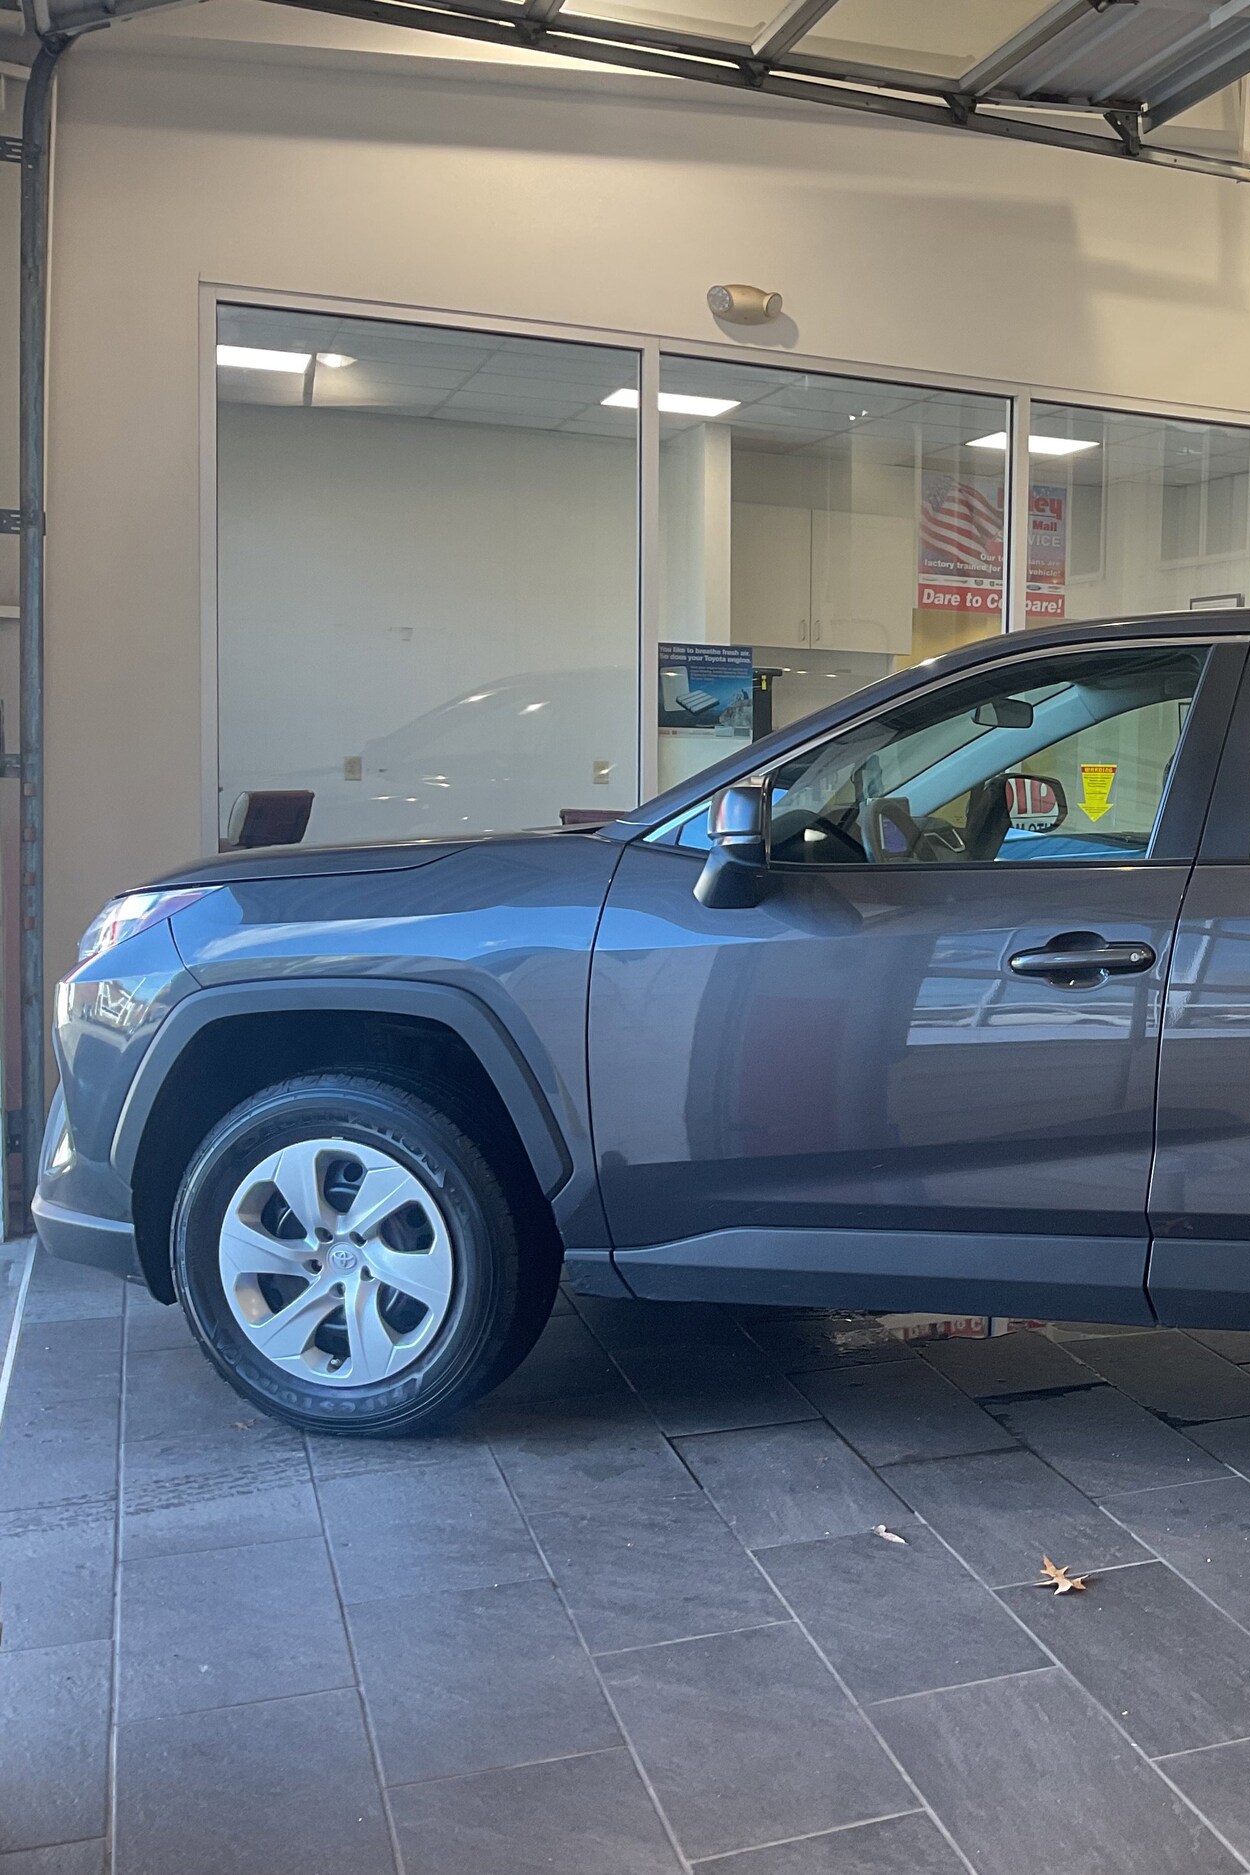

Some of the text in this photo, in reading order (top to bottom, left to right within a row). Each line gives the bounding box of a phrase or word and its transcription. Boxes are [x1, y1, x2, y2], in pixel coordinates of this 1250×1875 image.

[1032, 520, 1058, 532] Mall
[1028, 534, 1060, 547] VICE
[980, 553, 996, 562] Our
[924, 559, 955, 570] factory
[922, 588, 1063, 613] Dare to Cpare!
[704, 655, 727, 663] Toyota
